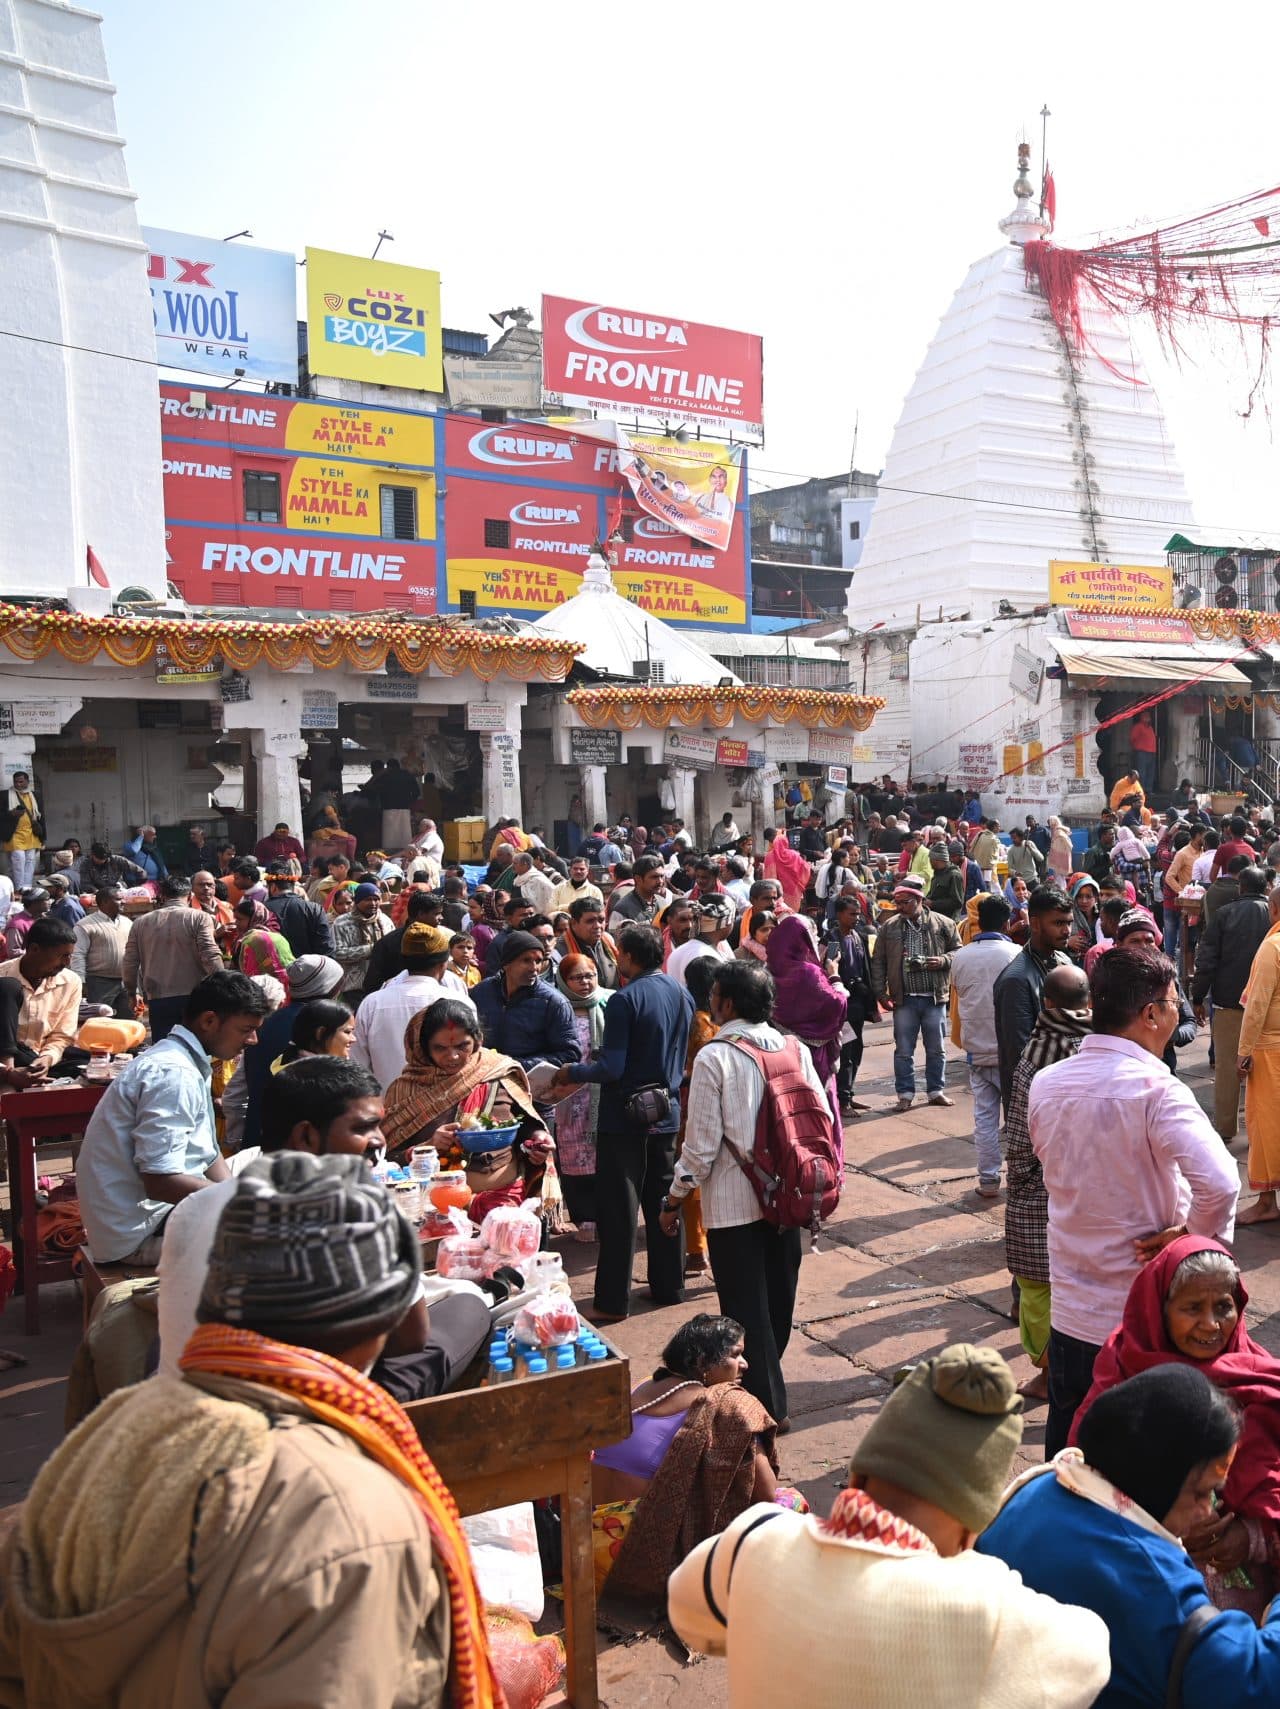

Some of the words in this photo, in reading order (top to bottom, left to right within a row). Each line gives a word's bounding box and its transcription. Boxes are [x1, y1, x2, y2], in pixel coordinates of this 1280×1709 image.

[366, 287, 408, 303] LUX
[163, 289, 249, 343] WOOL
[348, 297, 425, 327] COZI
[598, 311, 688, 345] RUPA
[185, 342, 249, 361] WEAR
[565, 351, 744, 405] FRONTLINE
[662, 396, 689, 407] STYLE
[699, 403, 730, 413] MAMLA
[340, 410, 360, 419] YEH
[320, 417, 373, 433] STYLE
[381, 426, 394, 435] KA
[312, 430, 387, 447] MAMLA
[494, 434, 575, 461] RUPA
[161, 459, 232, 480] ONTLINE
[320, 467, 344, 477] YEH
[301, 478, 353, 497] STYLE
[356, 488, 369, 498] KA
[288, 495, 368, 517] MAMLA
[525, 505, 580, 523] RUPA
[514, 537, 591, 555] FRONTLINE
[202, 541, 407, 581] FRONTLINE
[624, 547, 716, 569] FRONTLINE
[484, 571, 502, 582] YEH
[502, 568, 558, 587] STYLE
[1080, 567, 1123, 581] पार्वती
[482, 583, 495, 593] KA
[493, 584, 566, 604] MAMLA
[627, 582, 644, 592] YEH
[643, 579, 694, 596] STYLE
[638, 595, 701, 613] MAMLA
